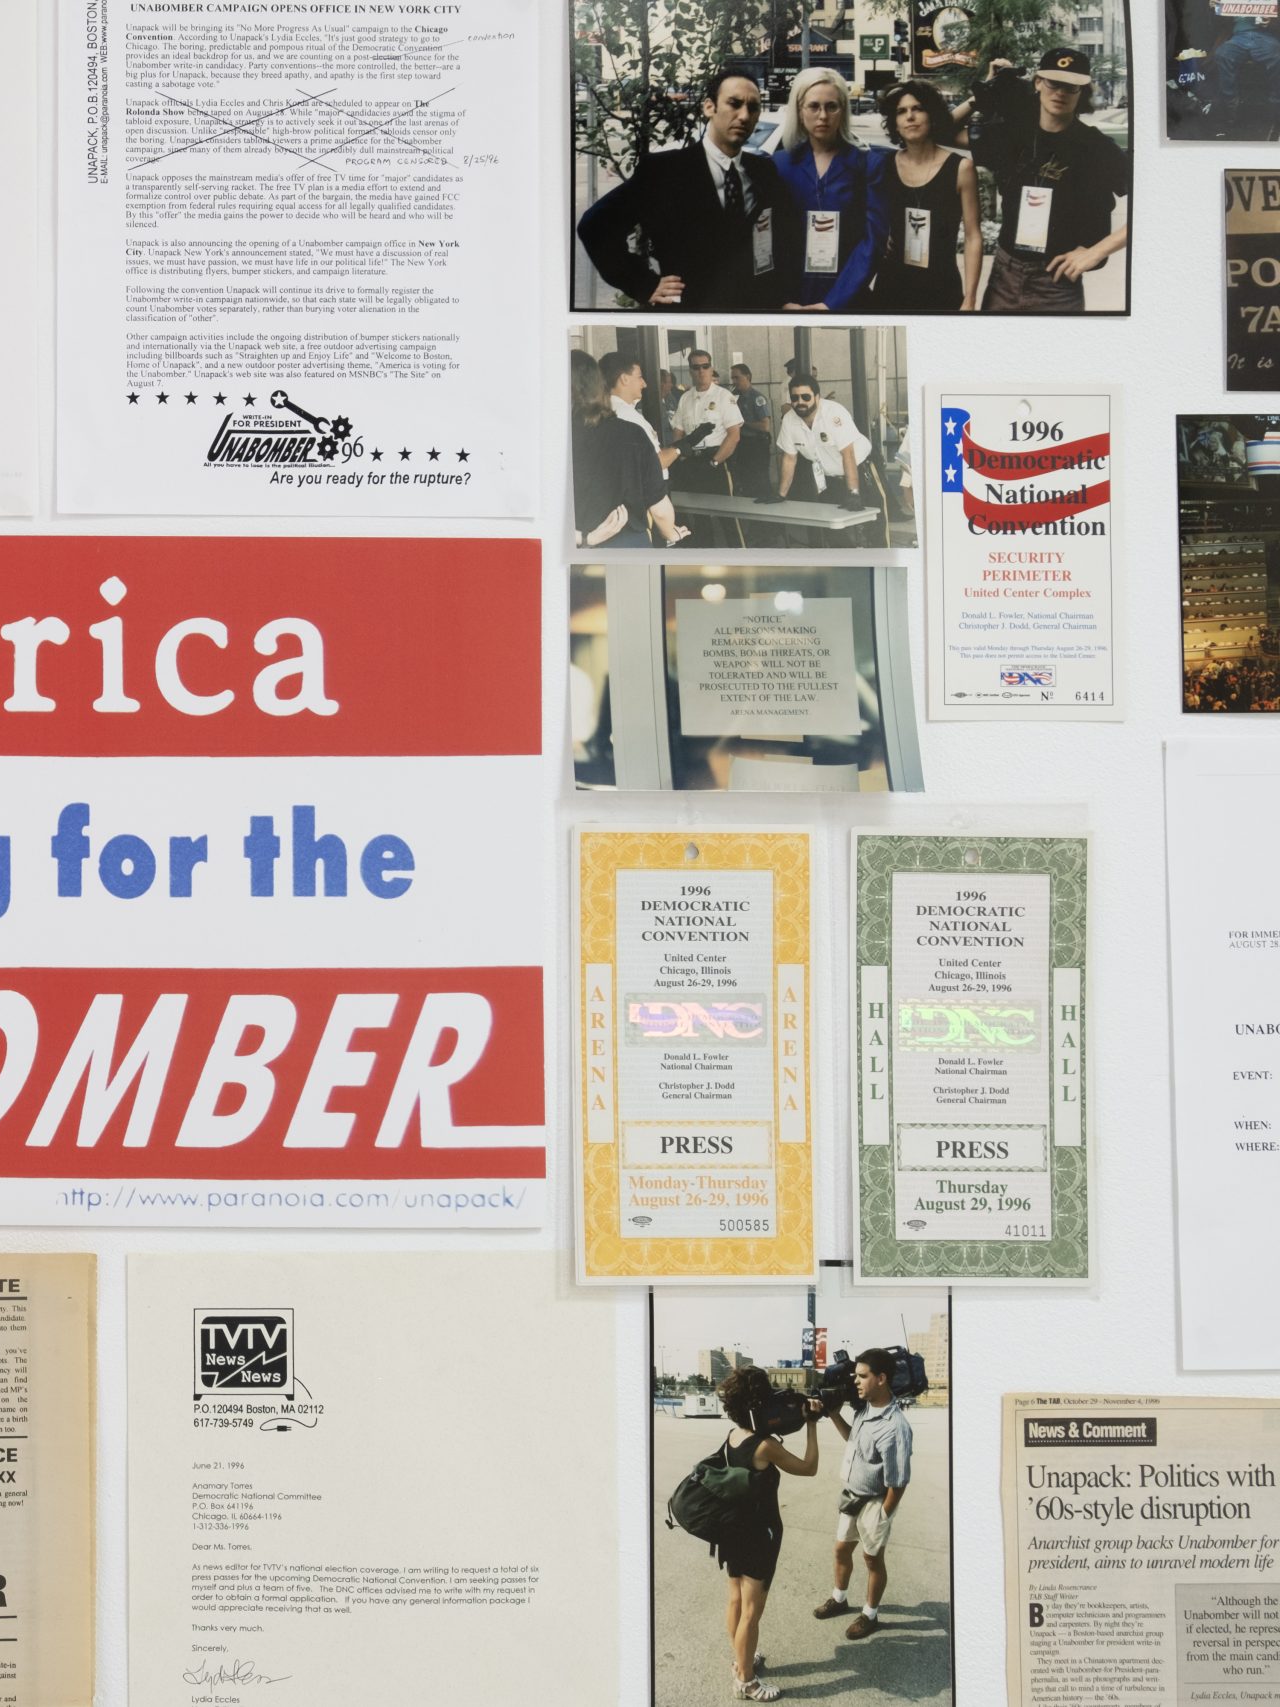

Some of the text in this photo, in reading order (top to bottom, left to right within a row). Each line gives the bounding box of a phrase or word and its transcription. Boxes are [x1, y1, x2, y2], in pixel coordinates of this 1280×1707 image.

[131, 3, 462, 14] UNABOMBER CAMPAIGN OPENS OFFICE IN NEW YORK CITY
[1221, 4, 1277, 14] UNABOMBER
[232, 419, 302, 428] FOR PRESIDENT
[207, 412, 364, 464] UNABOMBER 96
[1008, 421, 1064, 442] 1996
[967, 448, 1107, 471] Democratic
[270, 471, 471, 488] Are you ready for the rupture?
[985, 483, 1088, 505] National
[968, 514, 1106, 536] Convention
[988, 551, 1065, 564] SECURITY
[982, 570, 1072, 582] PERIMETER
[964, 587, 1092, 601] United Center Complex
[714, 626, 817, 635] ALL PERSONS MAKING
[51, 803, 208, 899] for
[244, 805, 415, 899] the
[680, 886, 711, 896] 1996
[955, 891, 987, 901] 1996
[641, 901, 751, 912] DEMOCRATIC
[916, 905, 1026, 917] DEMOCRATIC
[653, 916, 737, 927] NATIONAL
[928, 921, 1012, 932] NATIONAL
[641, 931, 750, 942] CONVENTION
[916, 936, 1025, 947] CONVENTION
[591, 986, 606, 1110] ARENA
[783, 987, 798, 1110] ARENA
[868, 1002, 884, 1100] HALL
[1060, 1004, 1076, 1102] HALL
[1232, 1071, 1273, 1081] EVENT:
[1233, 1121, 1272, 1130] WHEN:
[660, 1136, 734, 1154] PRESS
[936, 1141, 1009, 1159] PRESS
[1235, 1142, 1280, 1152] WHERE:
[628, 1175, 767, 1192] Monday-Thursday
[936, 1180, 1008, 1197] Thursday
[914, 1198, 1031, 1212] August 29, 1996
[719, 1219, 769, 1231] 500585
[1005, 1224, 1047, 1237] 41011
[202, 1324, 287, 1350] TVTV
[205, 1353, 246, 1366] News
[240, 1370, 282, 1383] News
[193, 1404, 324, 1415] P.O.120494 Boston, MA 02112
[194, 1418, 253, 1427] 617-739-5749
[1029, 1422, 1146, 1438] News & Comment
[1026, 1464, 1276, 1495] Unapack: Politics with
[1028, 1496, 1251, 1526] '60s-style disruption
